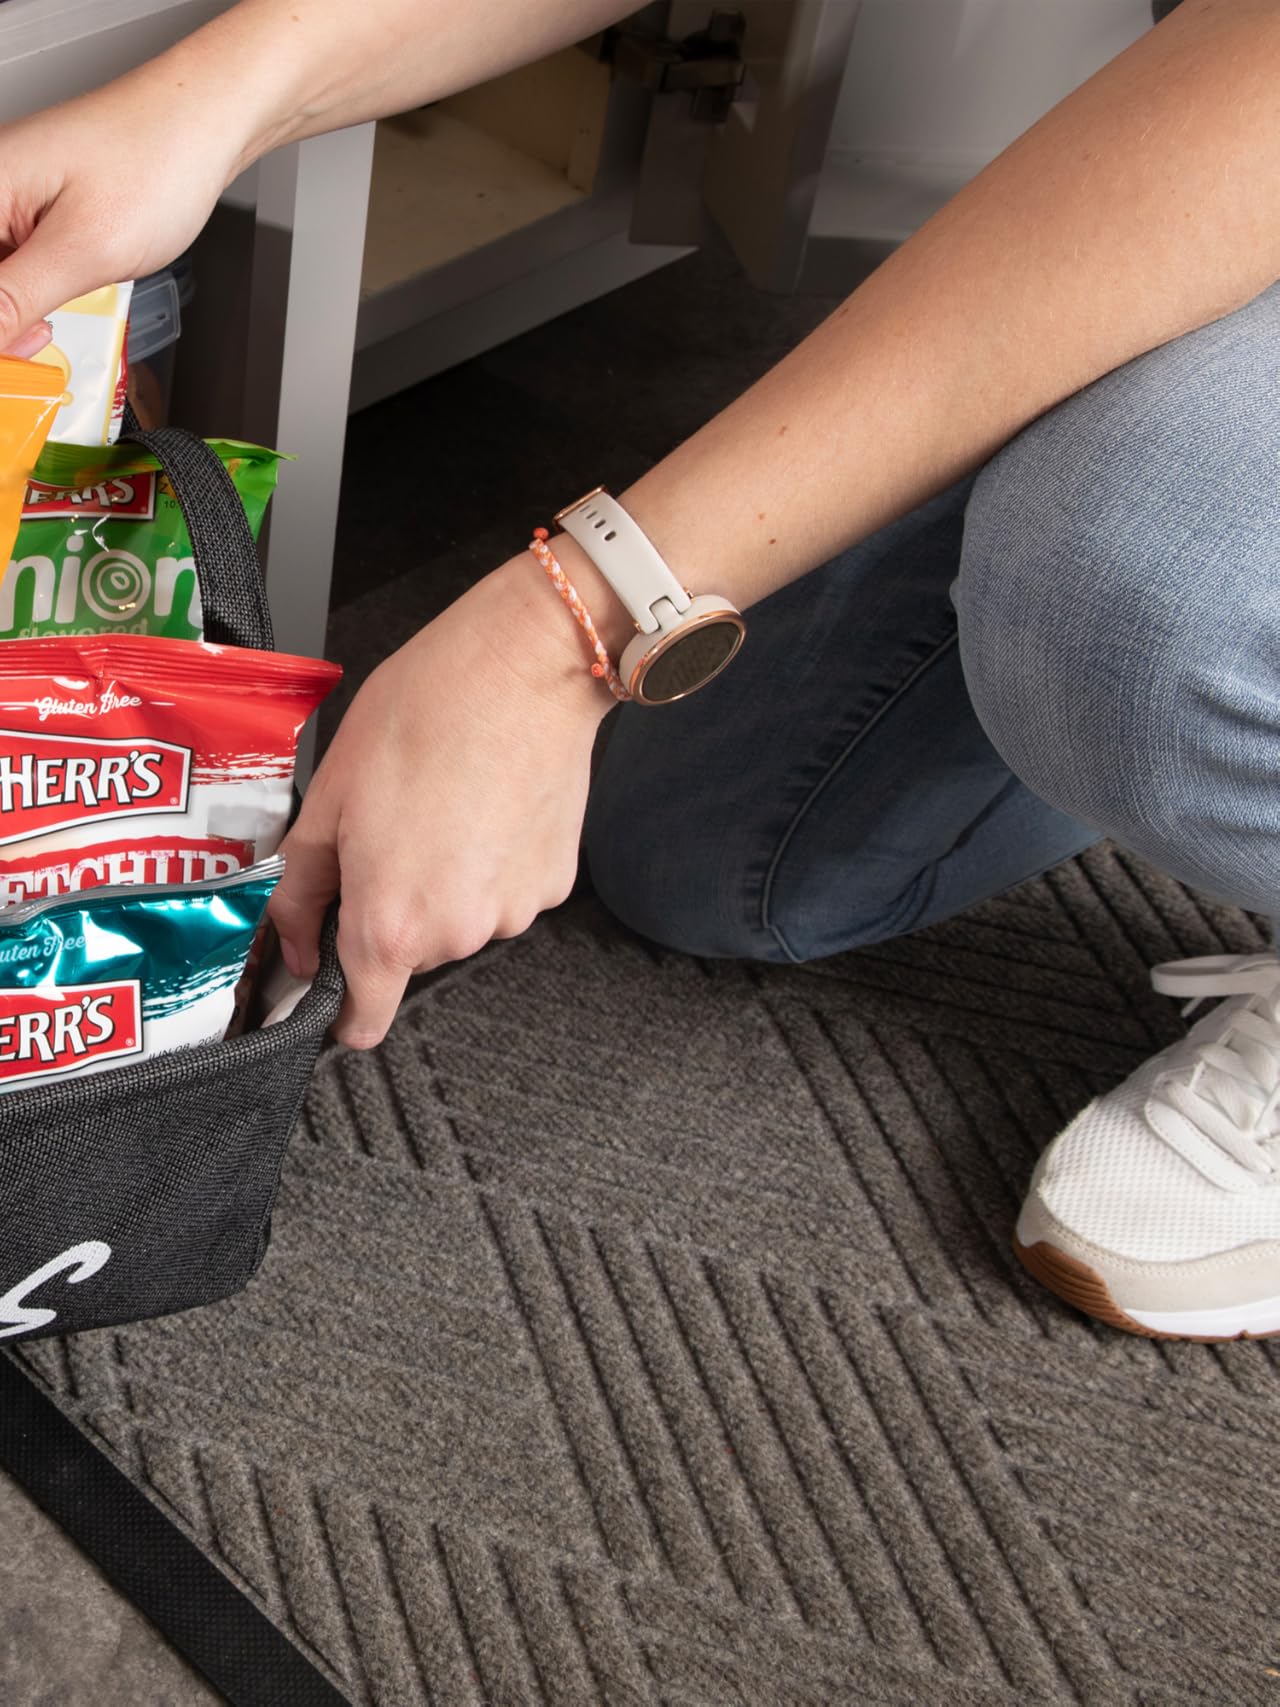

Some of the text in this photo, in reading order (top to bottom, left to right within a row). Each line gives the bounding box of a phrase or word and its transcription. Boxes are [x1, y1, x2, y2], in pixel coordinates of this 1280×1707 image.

[34, 682, 143, 721] Gluten Free
[41, 934, 87, 957] Free
